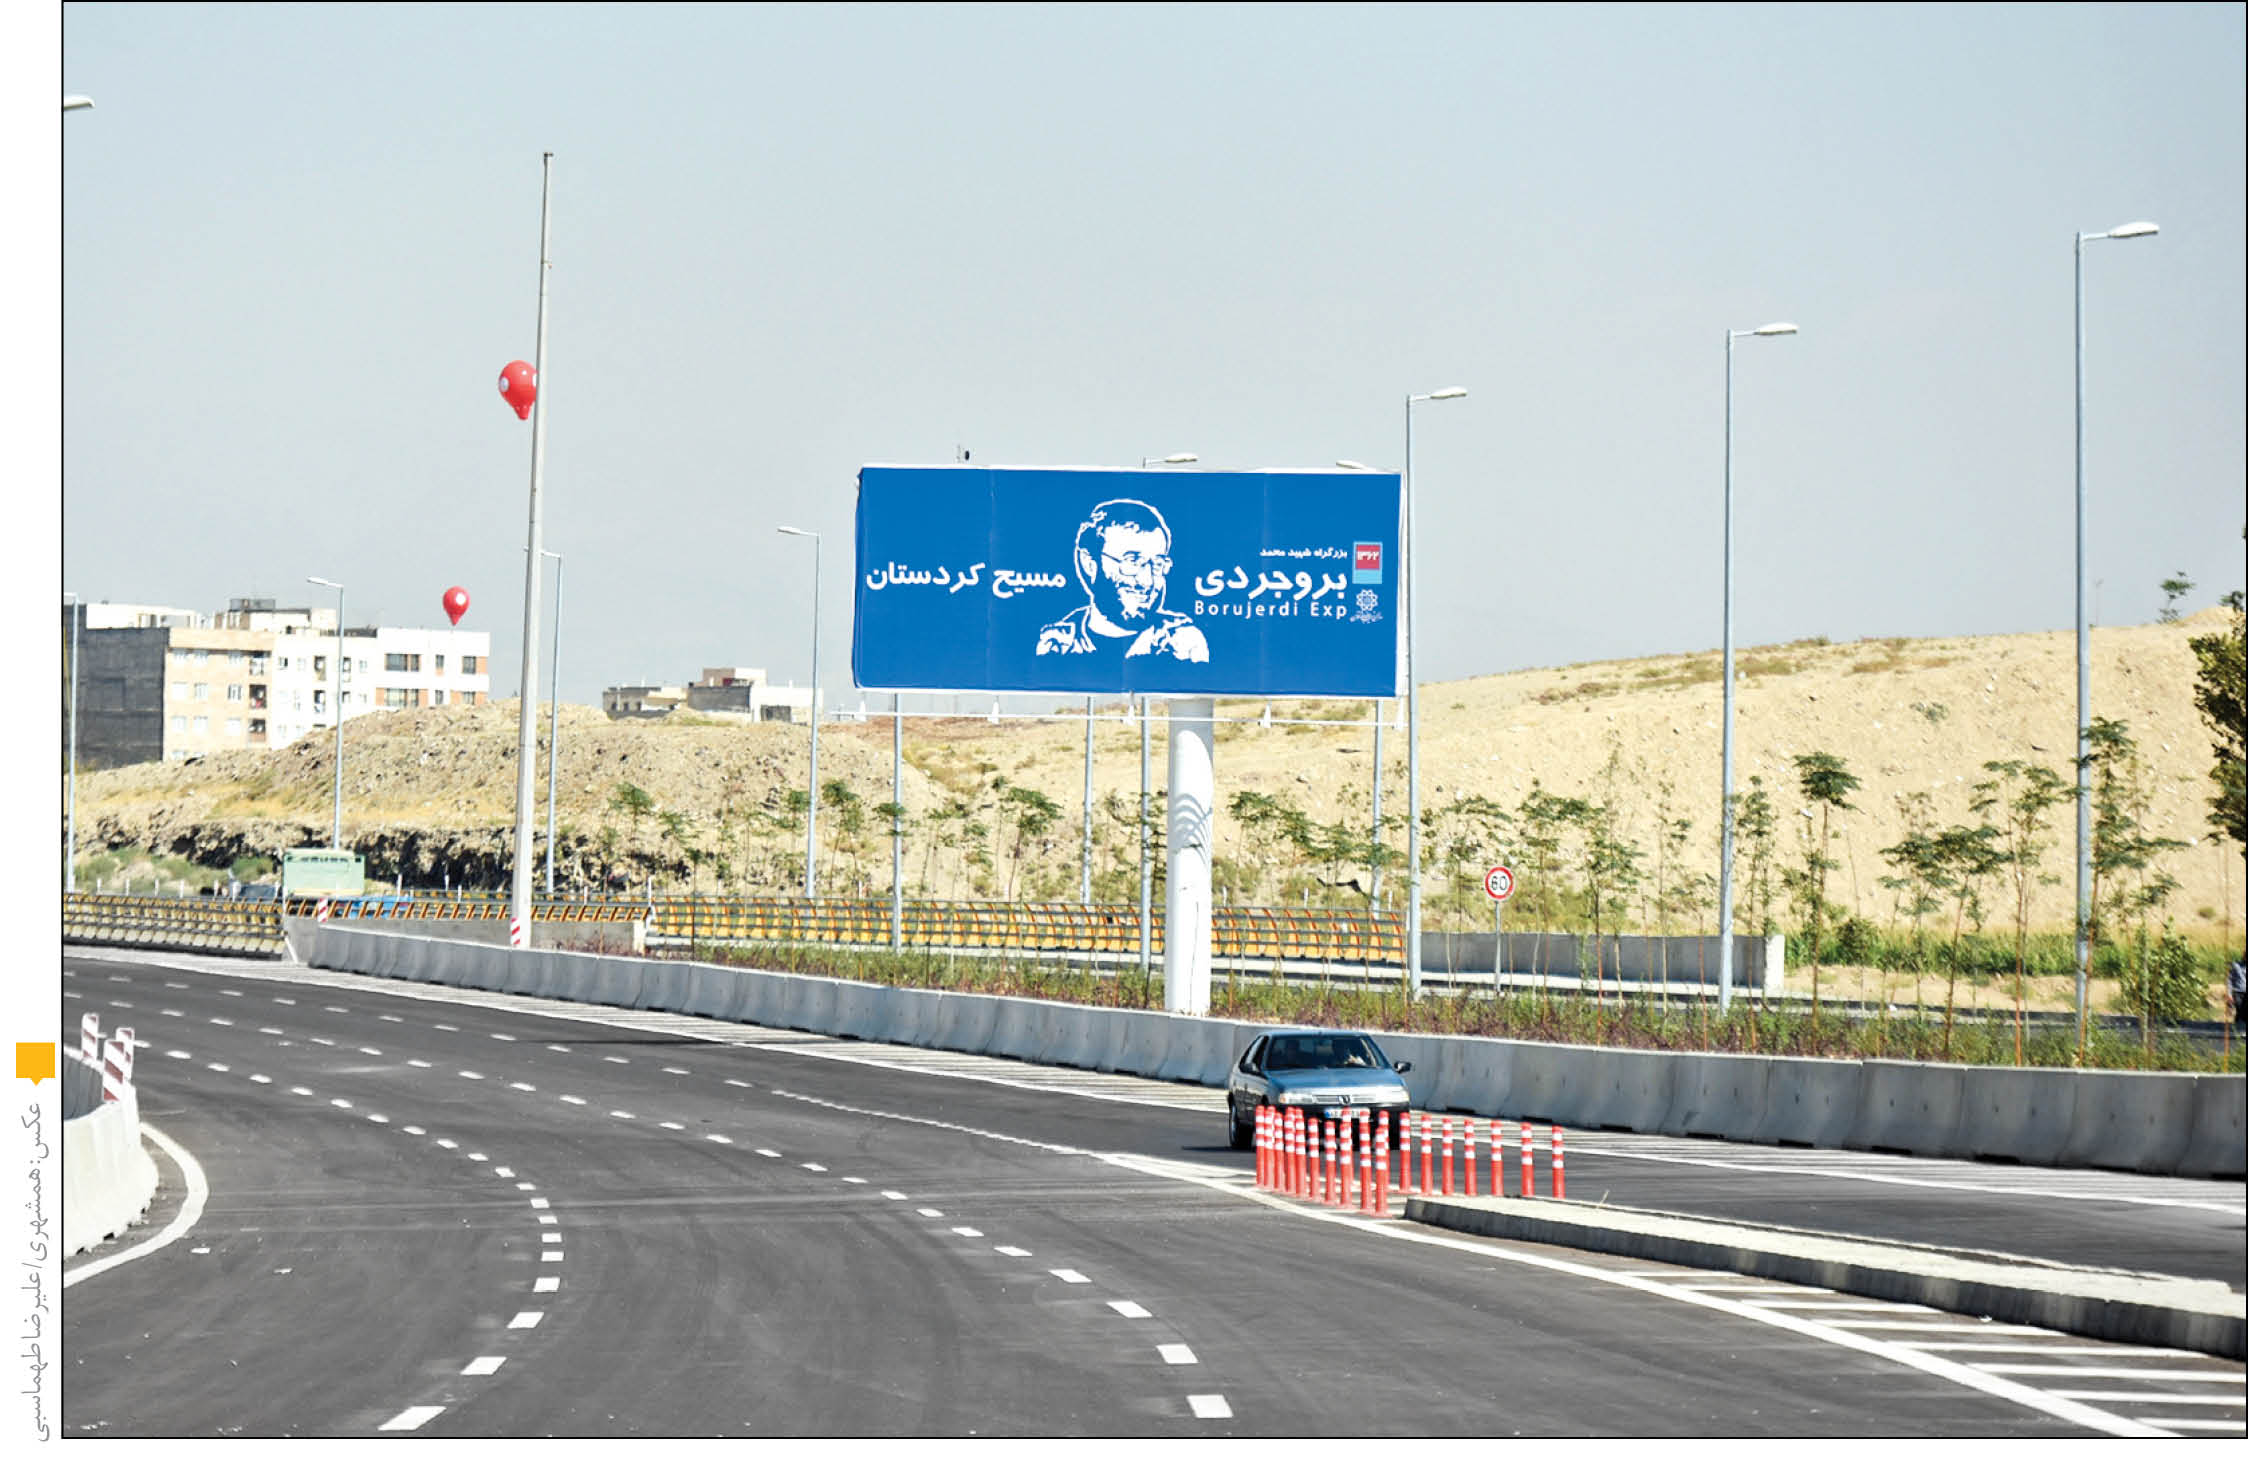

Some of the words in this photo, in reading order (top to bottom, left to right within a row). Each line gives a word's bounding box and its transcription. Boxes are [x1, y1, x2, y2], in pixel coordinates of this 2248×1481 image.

[1259, 547, 1286, 557] محمد
[1287, 547, 1312, 560] شهید
[1313, 546, 1348, 560] بزرگراه
[866, 561, 986, 594] کردستان
[992, 569, 1067, 599] مسیح
[1194, 565, 1348, 601] بروجردی
[1194, 600, 1299, 620] Borujerdi
[1310, 601, 1347, 620] Exp
[1491, 875, 1508, 891] 60
